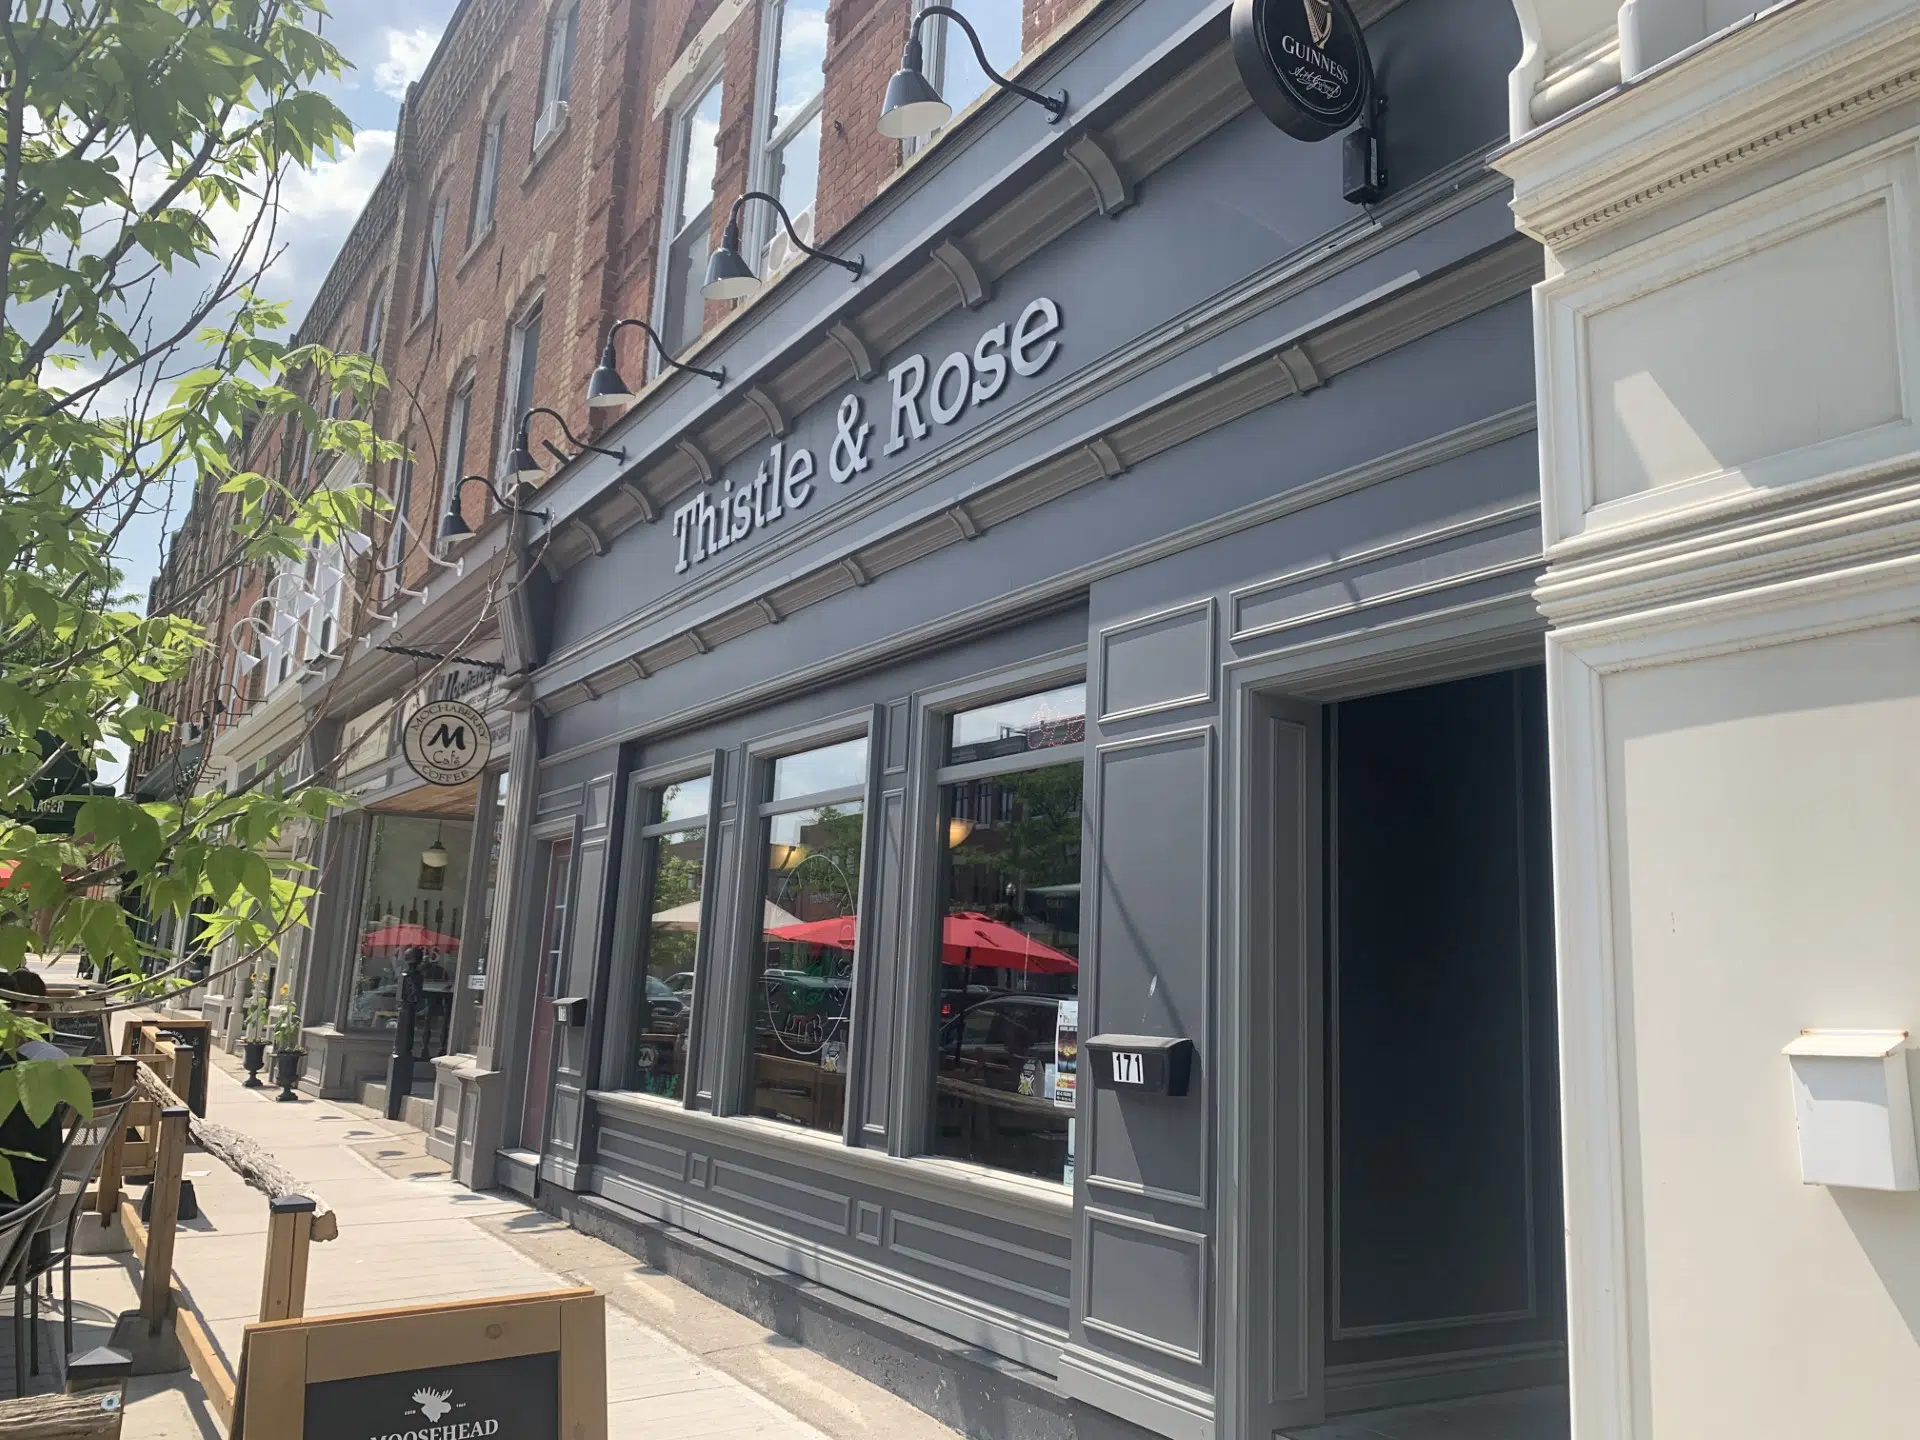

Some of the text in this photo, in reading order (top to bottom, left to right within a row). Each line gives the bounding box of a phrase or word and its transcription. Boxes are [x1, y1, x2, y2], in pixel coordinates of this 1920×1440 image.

[1282, 35, 1349, 84] GUINNESS
[672, 296, 1063, 574] Thistle & Rose
[410, 703, 487, 739] MOCHABERRY
[428, 723, 466, 751] M
[432, 750, 461, 766] Café
[421, 765, 469, 782] COFFEE
[1116, 1053, 1141, 1082] 171
